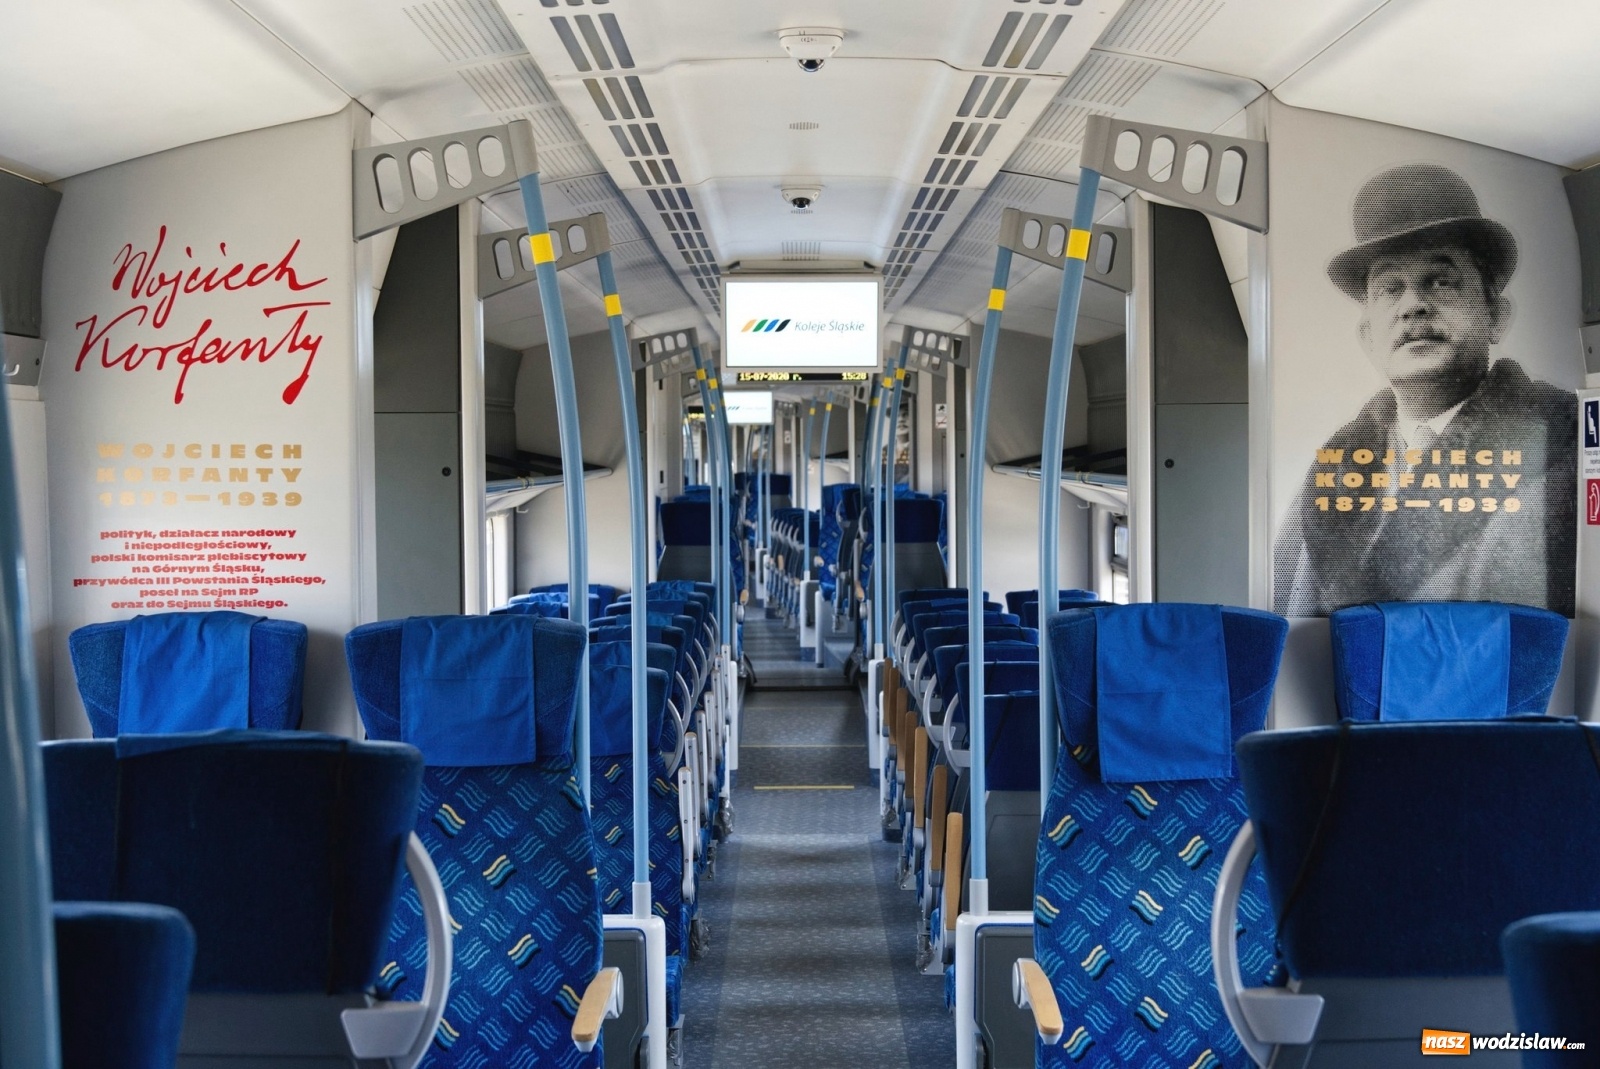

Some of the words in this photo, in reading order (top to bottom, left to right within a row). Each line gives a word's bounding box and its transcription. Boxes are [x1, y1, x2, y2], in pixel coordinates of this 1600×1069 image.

[112, 225, 328, 329] Wojciech
[794, 321, 826, 333] Koleje
[829, 320, 865, 333] Śląskie
[75, 302, 331, 404] Korfanty
[96, 443, 302, 459] WOJCIECH
[1316, 449, 1522, 465] WOJCIECH
[96, 468, 302, 483] KORFANTY
[1315, 473, 1521, 488] KORFANTY
[100, 530, 157, 540] polityk,
[159, 530, 219, 538] działacz
[221, 529, 296, 539] narodowy
[131, 540, 272, 551] niepodległościowy,
[91, 553, 136, 563] polski
[137, 553, 205, 561] komisarz
[207, 552, 306, 563] plebiscytowy
[132, 565, 150, 573] na
[152, 564, 210, 575] Górnym
[212, 563, 265, 575] Śląsku,
[74, 577, 154, 587] przywódca
[173, 576, 249, 584] Powstania
[252, 574, 326, 586] Śląskiego,
[139, 588, 179, 598] poseł
[201, 588, 237, 598] Sejm
[239, 588, 259, 596] RP
[111, 601, 144, 609] oraz
[146, 600, 165, 608] do
[167, 600, 211, 610] Sejmu
[214, 598, 288, 610] Śląskiego.
